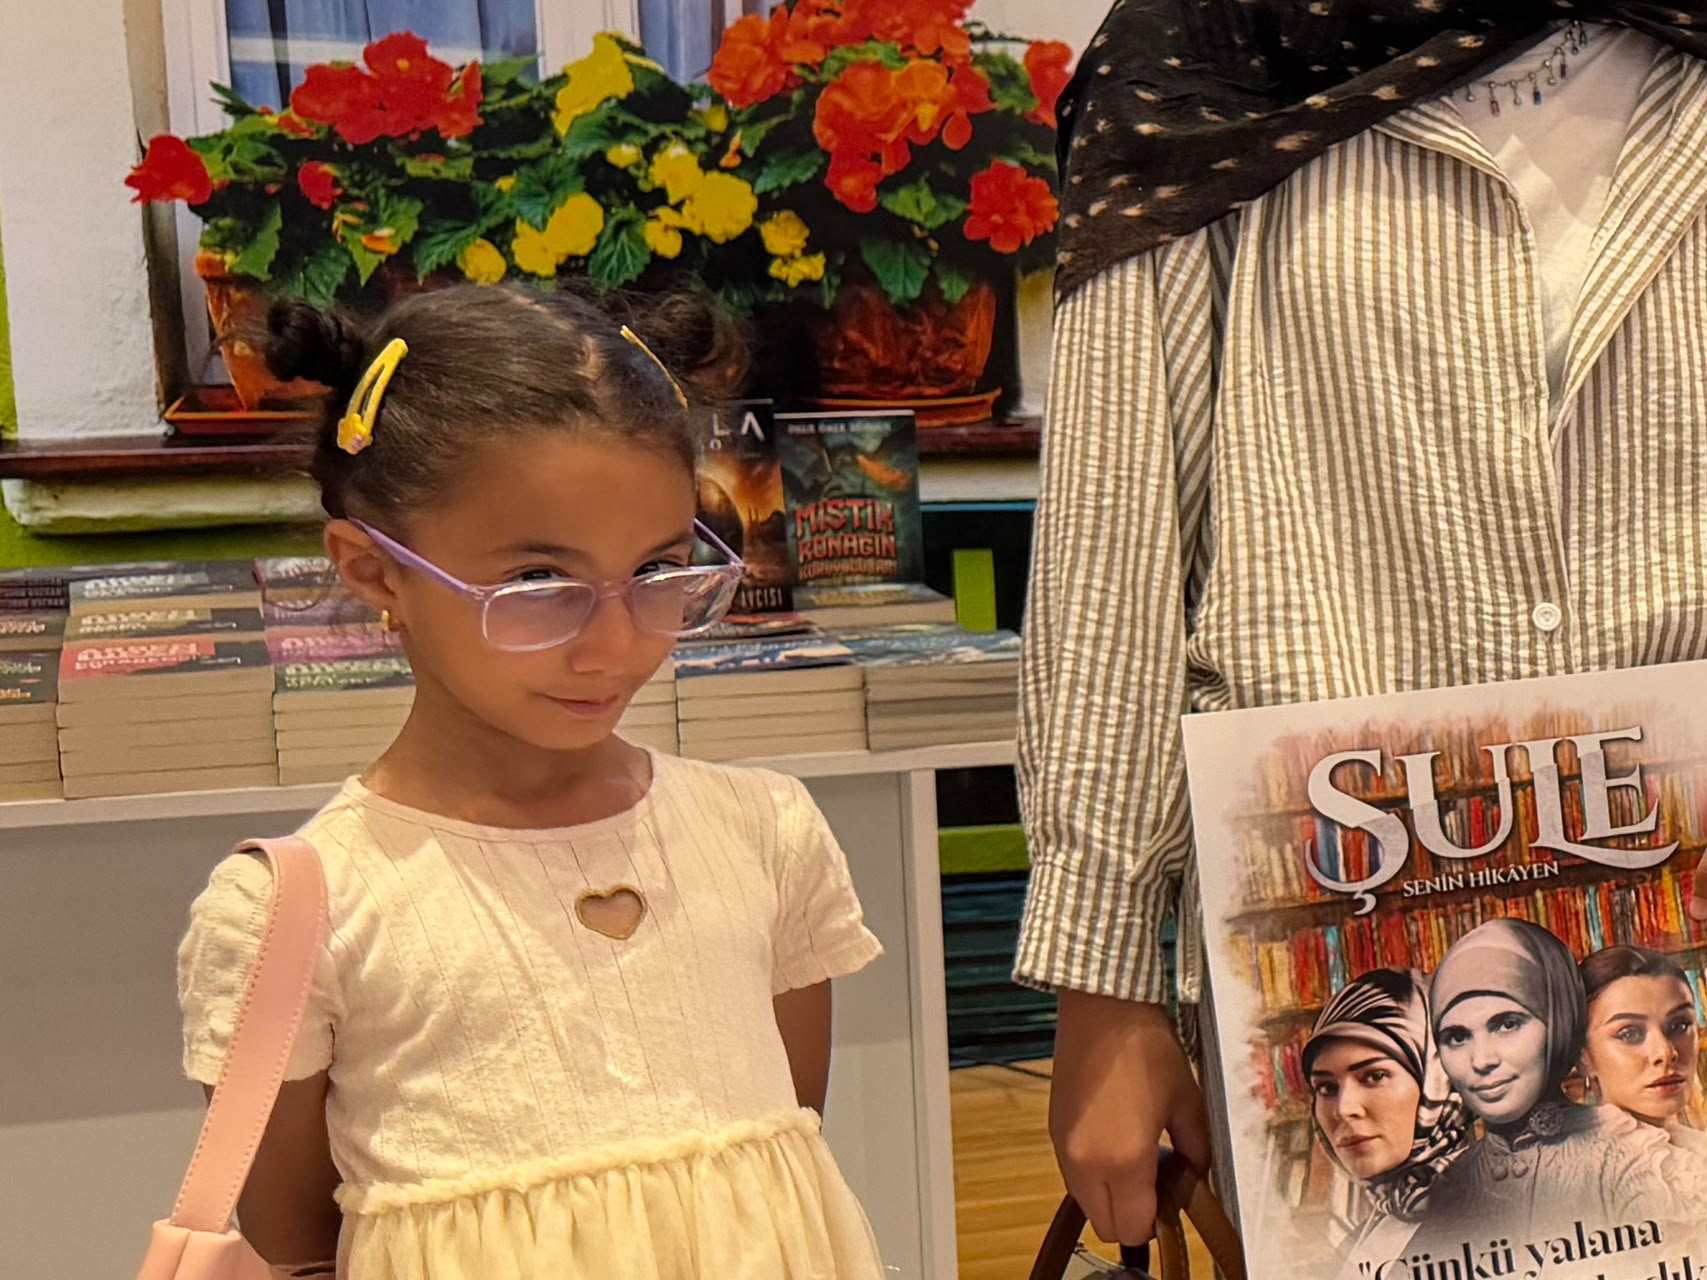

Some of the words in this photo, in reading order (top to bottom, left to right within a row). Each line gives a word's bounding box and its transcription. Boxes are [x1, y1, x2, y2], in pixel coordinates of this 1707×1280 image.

[1305, 726, 1680, 915] ŞULE
[1403, 873, 1465, 897] SENİN
[1469, 861, 1559, 889] HİKÂYEN
